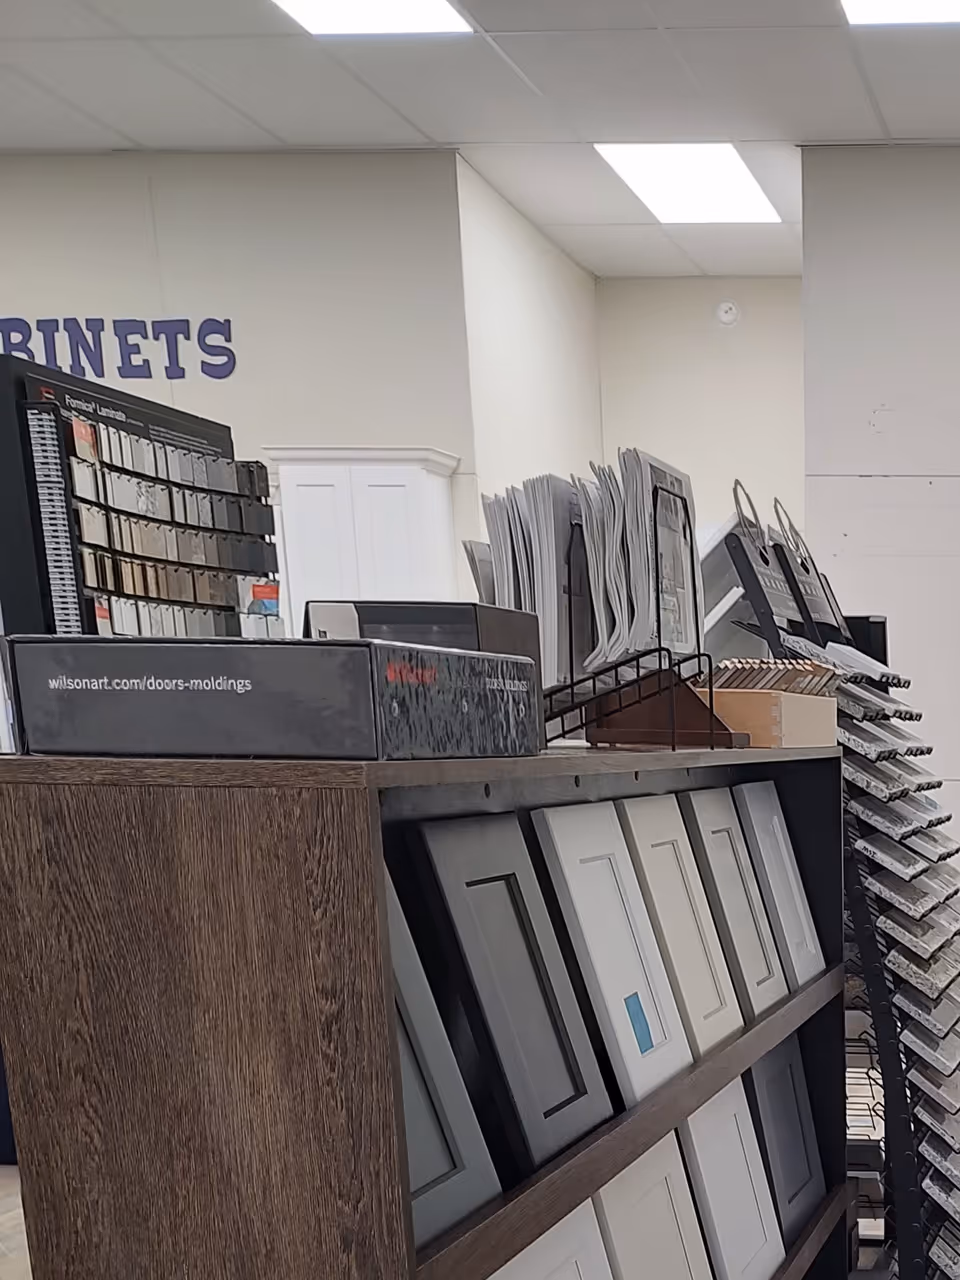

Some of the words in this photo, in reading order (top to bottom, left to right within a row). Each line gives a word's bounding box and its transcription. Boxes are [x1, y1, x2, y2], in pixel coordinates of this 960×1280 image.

[0, 318, 236, 380] BINETS
[96, 403, 126, 422] Laminate
[48, 675, 252, 693] wilsonart.com/doors-moldings
